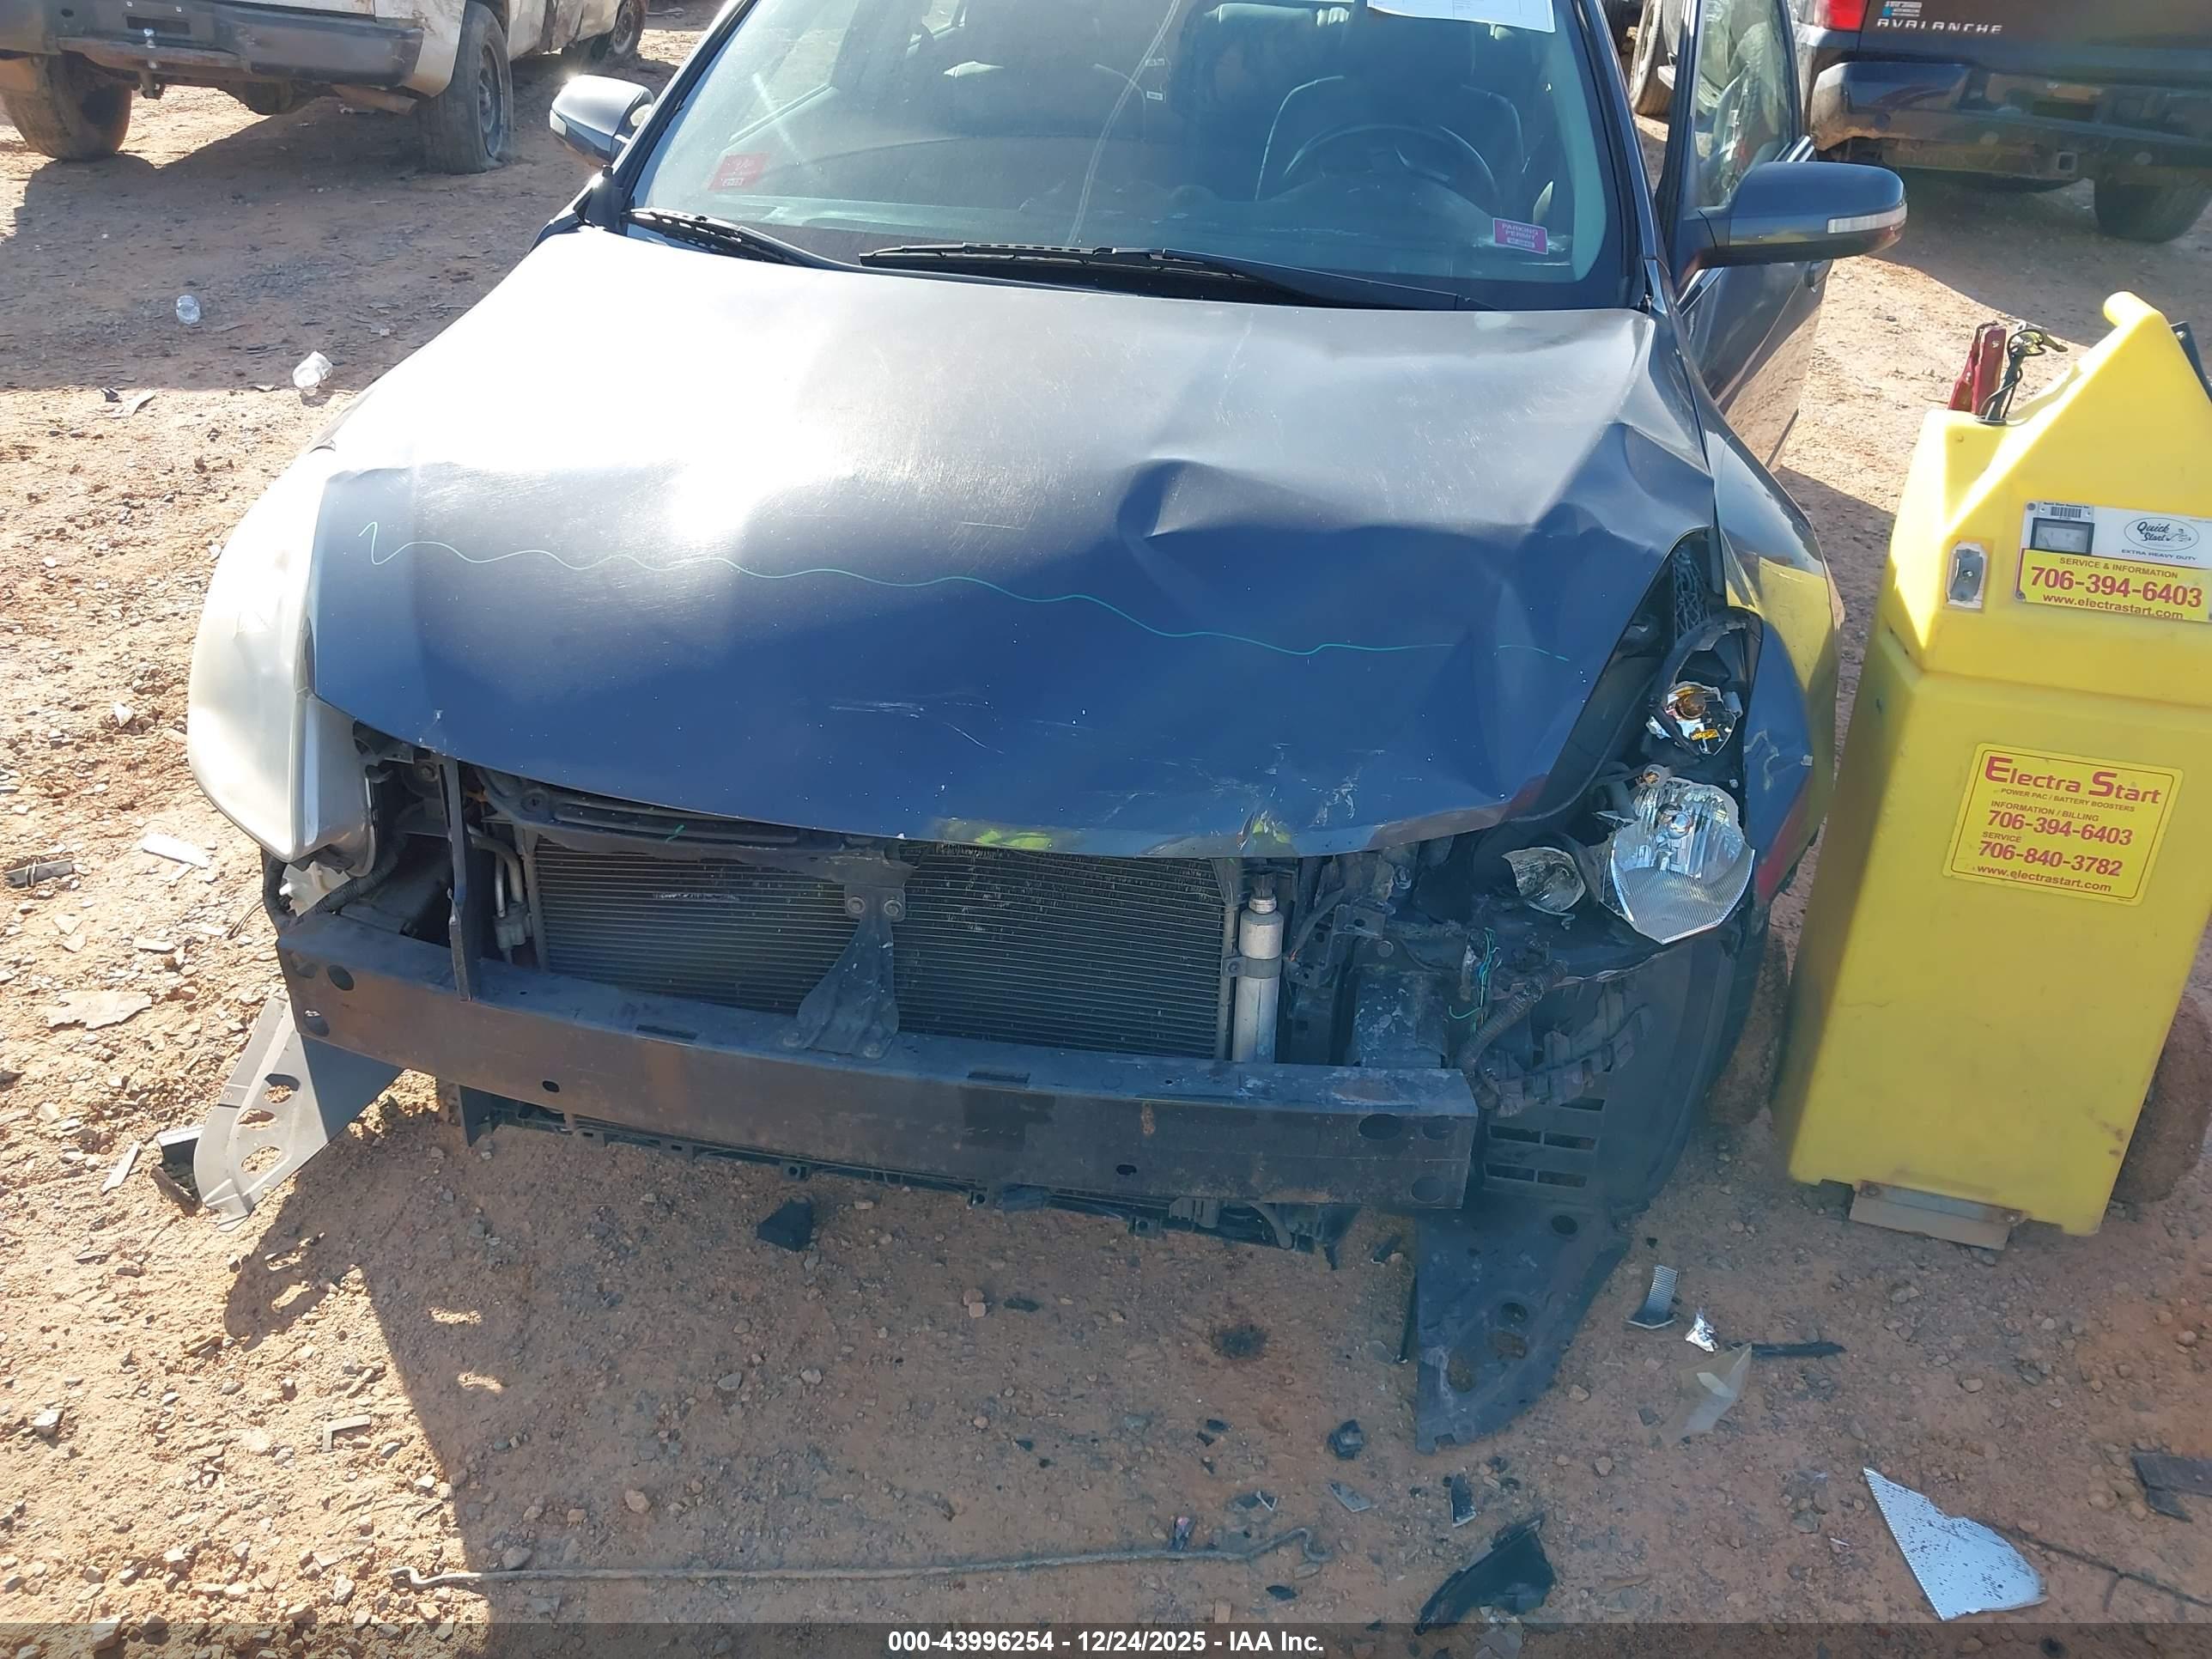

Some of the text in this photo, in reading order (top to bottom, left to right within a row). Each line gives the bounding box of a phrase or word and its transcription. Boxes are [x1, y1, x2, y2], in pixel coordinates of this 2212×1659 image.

[1877, 18, 2002, 34] AVALANCHE
[1502, 222, 1538, 235] PARKING
[1505, 229, 1536, 241] PERMIT
[2136, 521, 2170, 534] Quick
[2141, 532, 2167, 541] Start
[2059, 557, 2100, 568] SERVICE
[2112, 564, 2178, 579] INFORMATION
[2031, 566, 2203, 608] 706-394-6403
[2043, 593, 2184, 620] www.electrastart.com
[1985, 756, 2161, 804] Electra Start
[2001, 788, 2030, 798] POWER
[2053, 796, 2090, 805] BATTERY
[2091, 801, 2135, 811] BOOSTERS
[1991, 800, 2055, 815] INFORMATION
[2062, 811, 2100, 822] BILLING
[1982, 831, 2021, 843] SERVICE
[1988, 810, 2133, 846] 706-394-6403
[1978, 841, 2123, 877] 706-840-3782
[1977, 865, 2112, 891] www.electrastart.com
